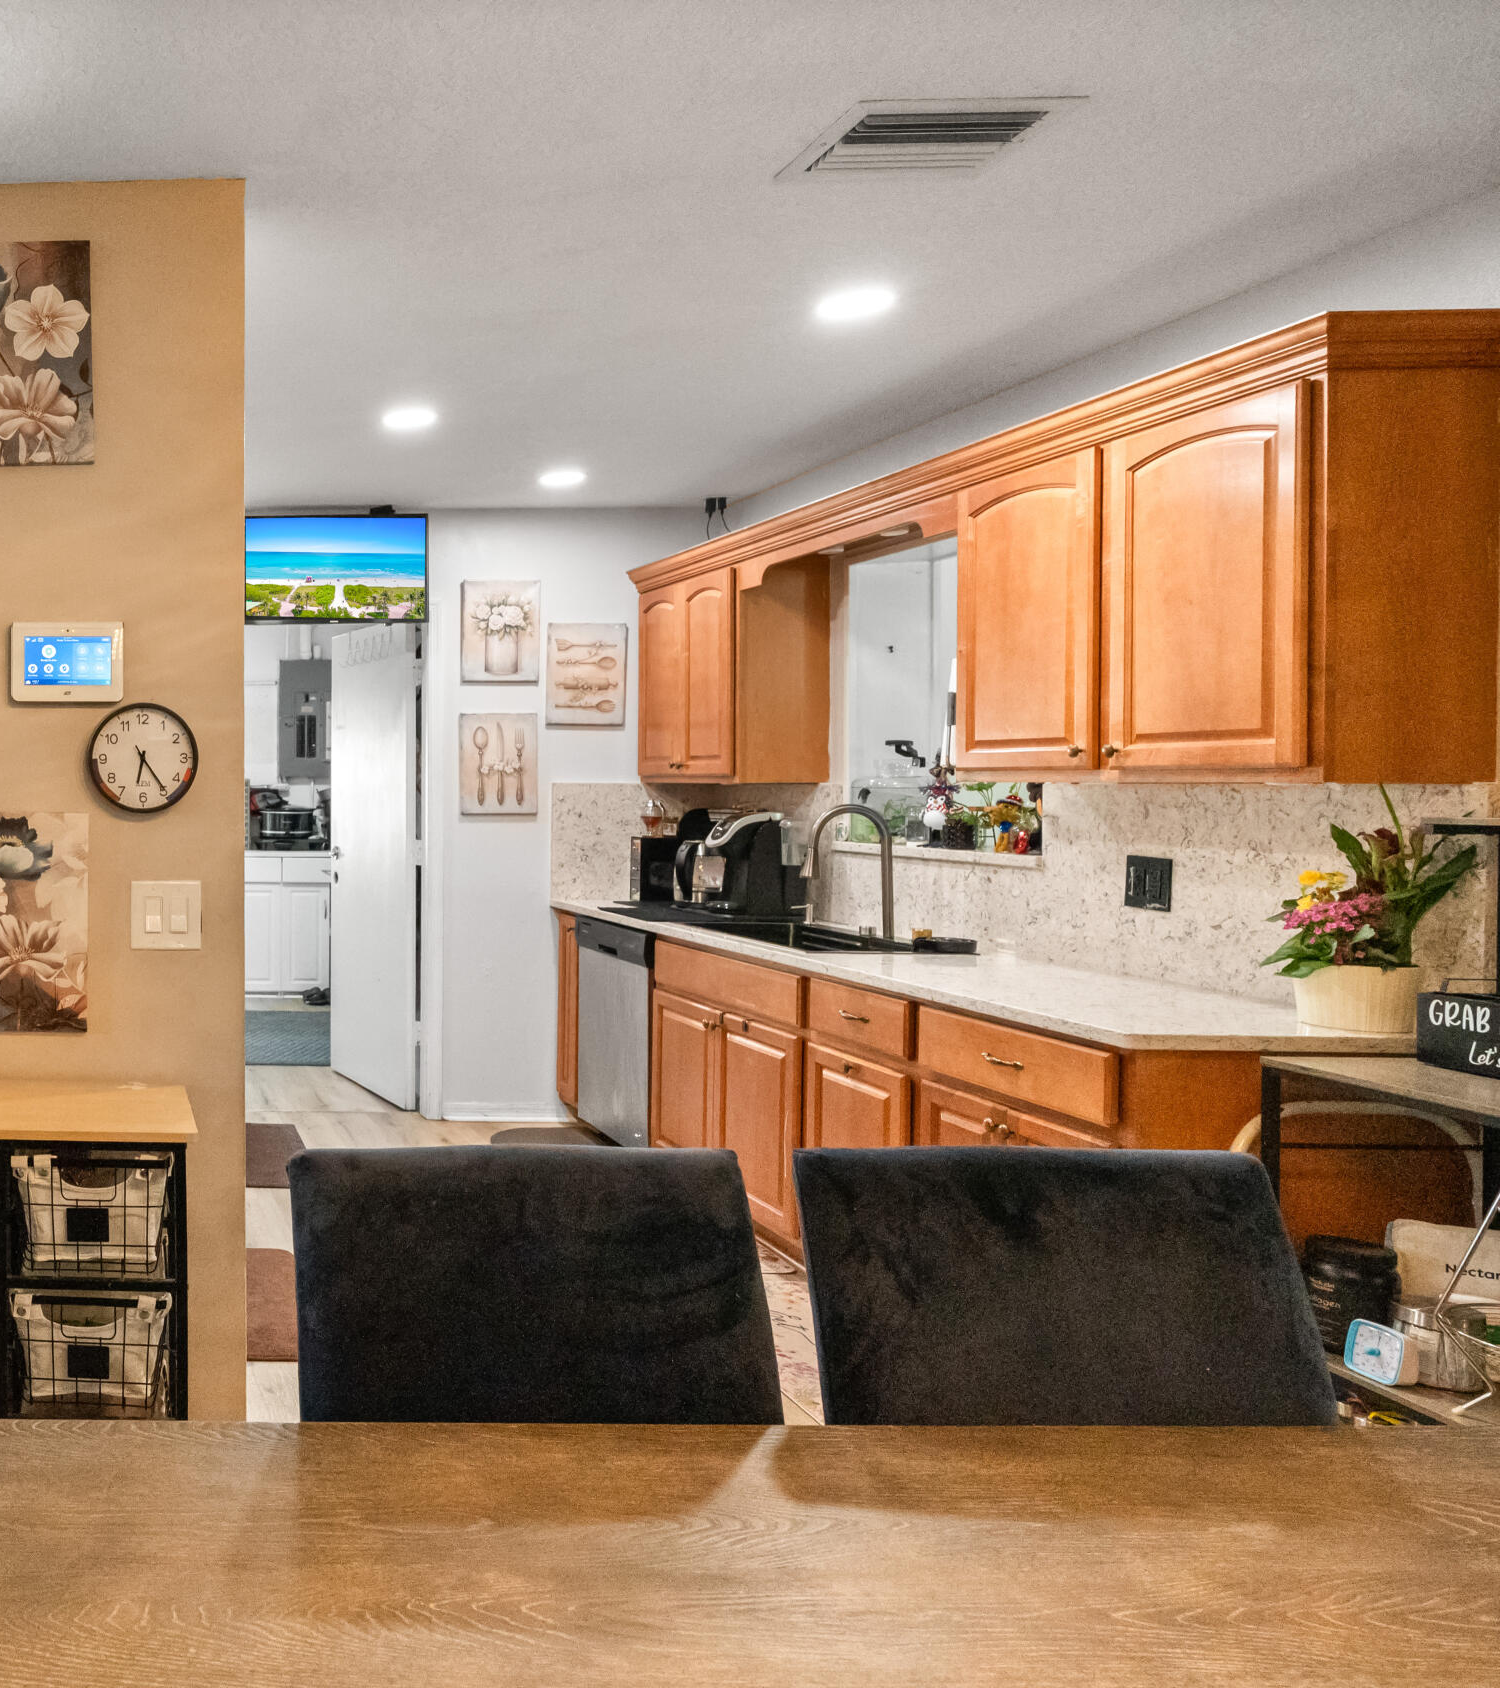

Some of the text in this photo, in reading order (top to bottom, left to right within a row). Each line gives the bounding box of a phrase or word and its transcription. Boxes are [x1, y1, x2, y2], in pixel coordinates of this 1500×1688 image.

[136, 713, 149, 725] 12
[120, 720, 130, 732] 11
[160, 720, 165, 731] 1
[105, 733, 118, 745] 10
[172, 733, 180, 744] 2
[99, 753, 107, 764] 9
[180, 752, 188, 764] 3
[107, 772, 116, 784] 8
[172, 772, 180, 783] 4
[118, 785, 126, 796] 7
[159, 785, 168, 797] 5
[139, 792, 147, 803] 6
[1428, 999, 1491, 1033] GRAB
